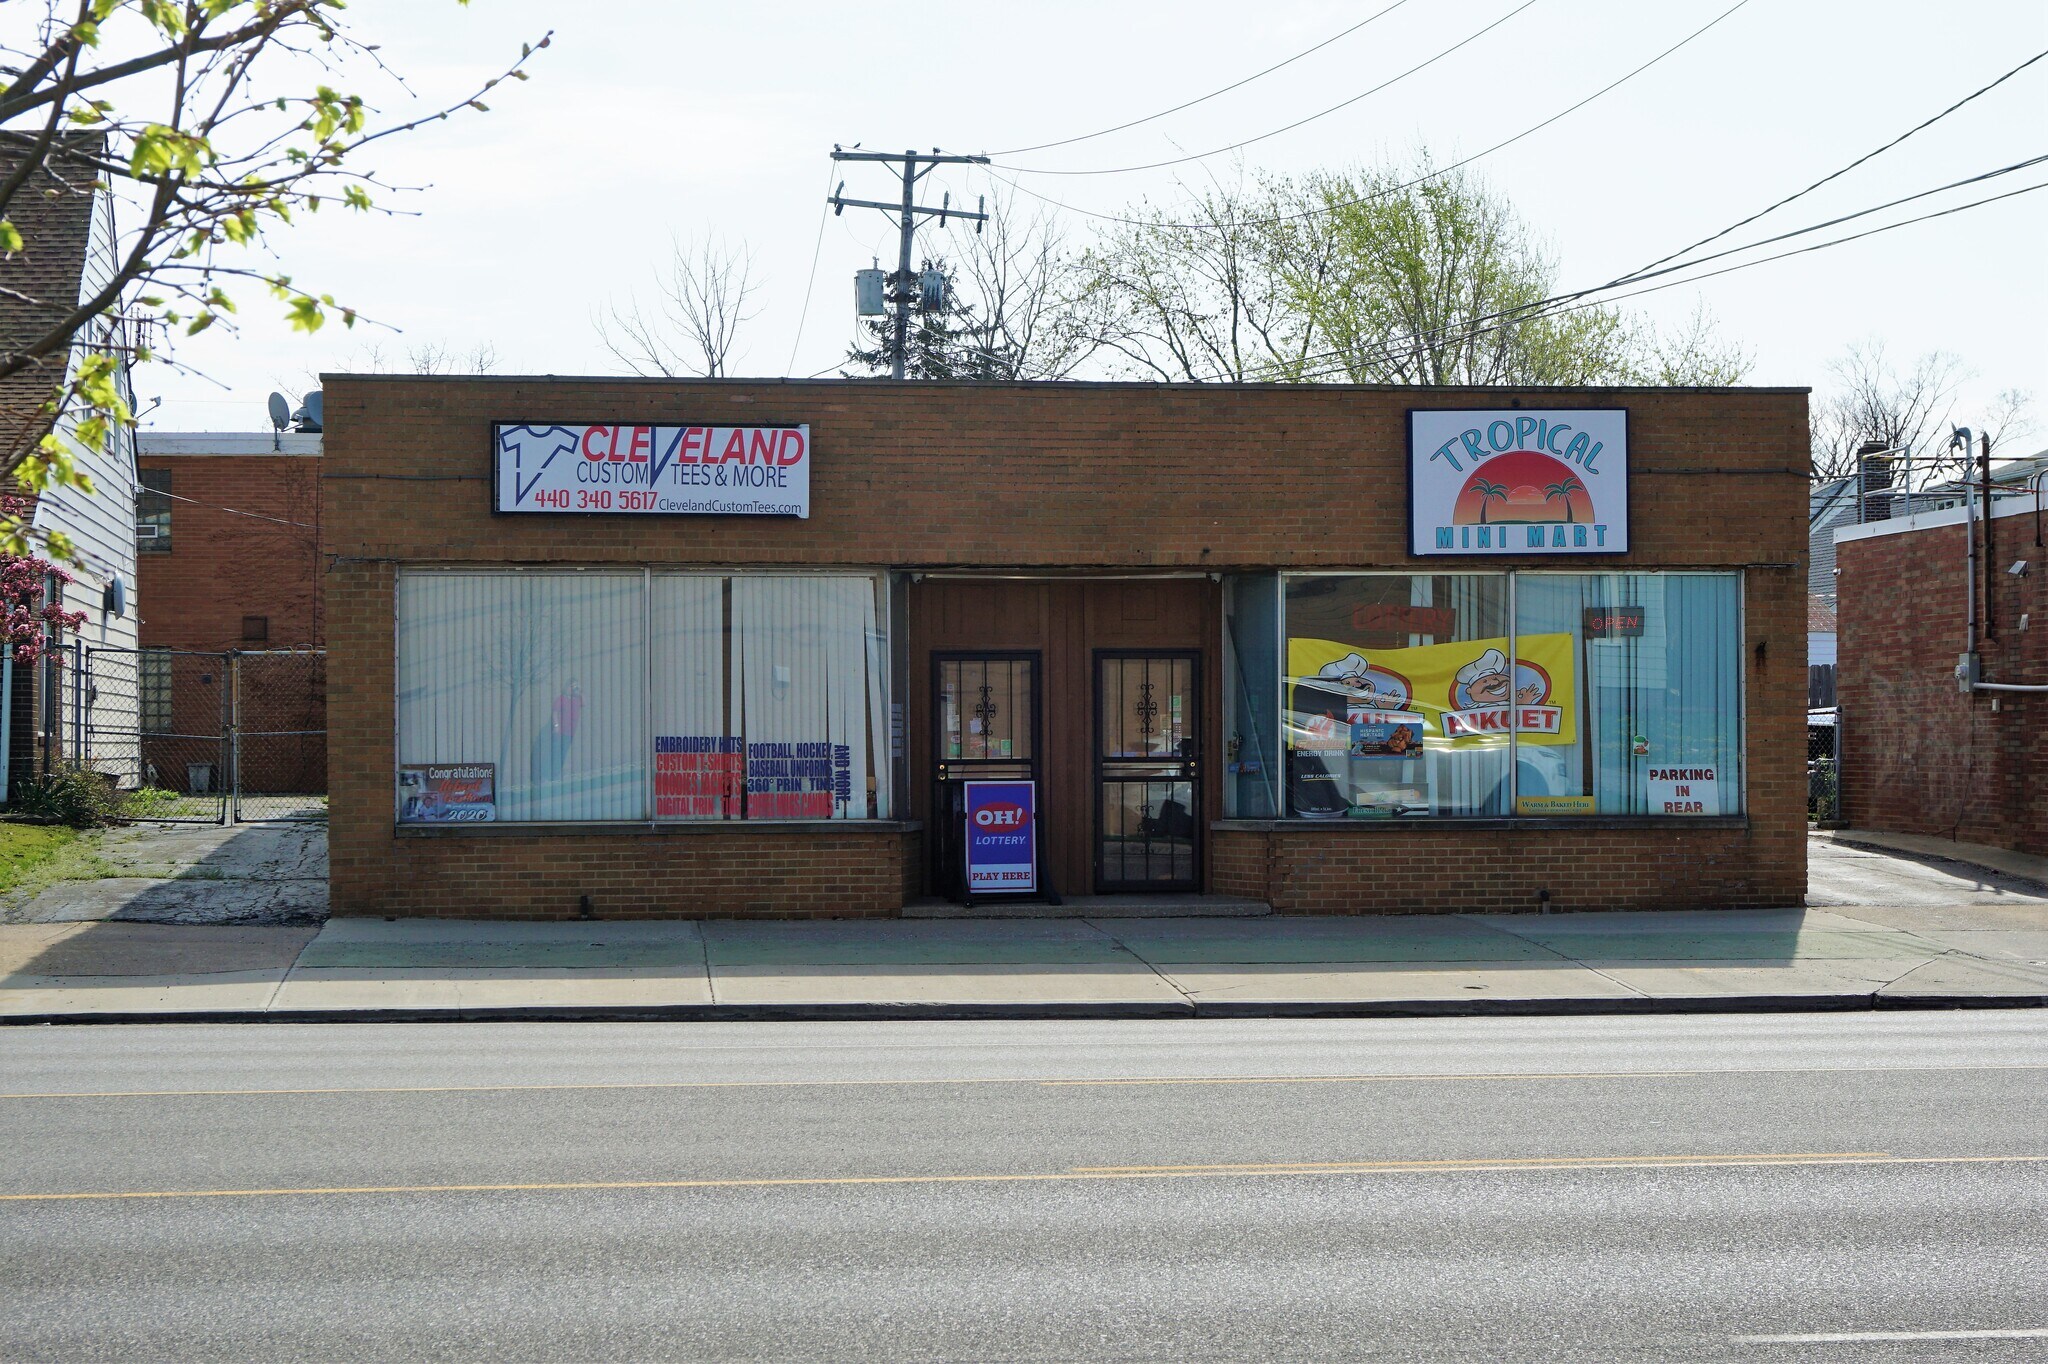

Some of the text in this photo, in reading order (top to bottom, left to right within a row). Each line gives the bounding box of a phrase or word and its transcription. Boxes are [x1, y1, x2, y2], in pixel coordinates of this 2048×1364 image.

[1429, 416, 1604, 475] TROPICAL
[581, 425, 805, 490] CLEVELAND
[577, 461, 787, 488] CUSTOM TEES & MORE
[534, 489, 801, 514] 440 340 5617 ClevelandCustomTees.com
[1435, 525, 1607, 548] MINI MART
[1592, 615, 1638, 630] OPEN
[1447, 709, 1558, 734] KIKUET
[655, 736, 717, 753] EMBROIDERY
[748, 742, 833, 760] FOOTBALL, HOCKEY,
[656, 754, 697, 771] CUSTOM
[834, 744, 850, 767] AND
[749, 759, 833, 777] BASEBALL UNIFORMS
[1649, 768, 1715, 781] PARKING
[1675, 785, 1690, 797] IN
[448, 809, 488, 821] 2020
[1664, 801, 1703, 814] REAR
[976, 808, 1022, 826] OH!
[976, 836, 1026, 845] LOTTERY
[972, 872, 1030, 881] PLAY HERE
